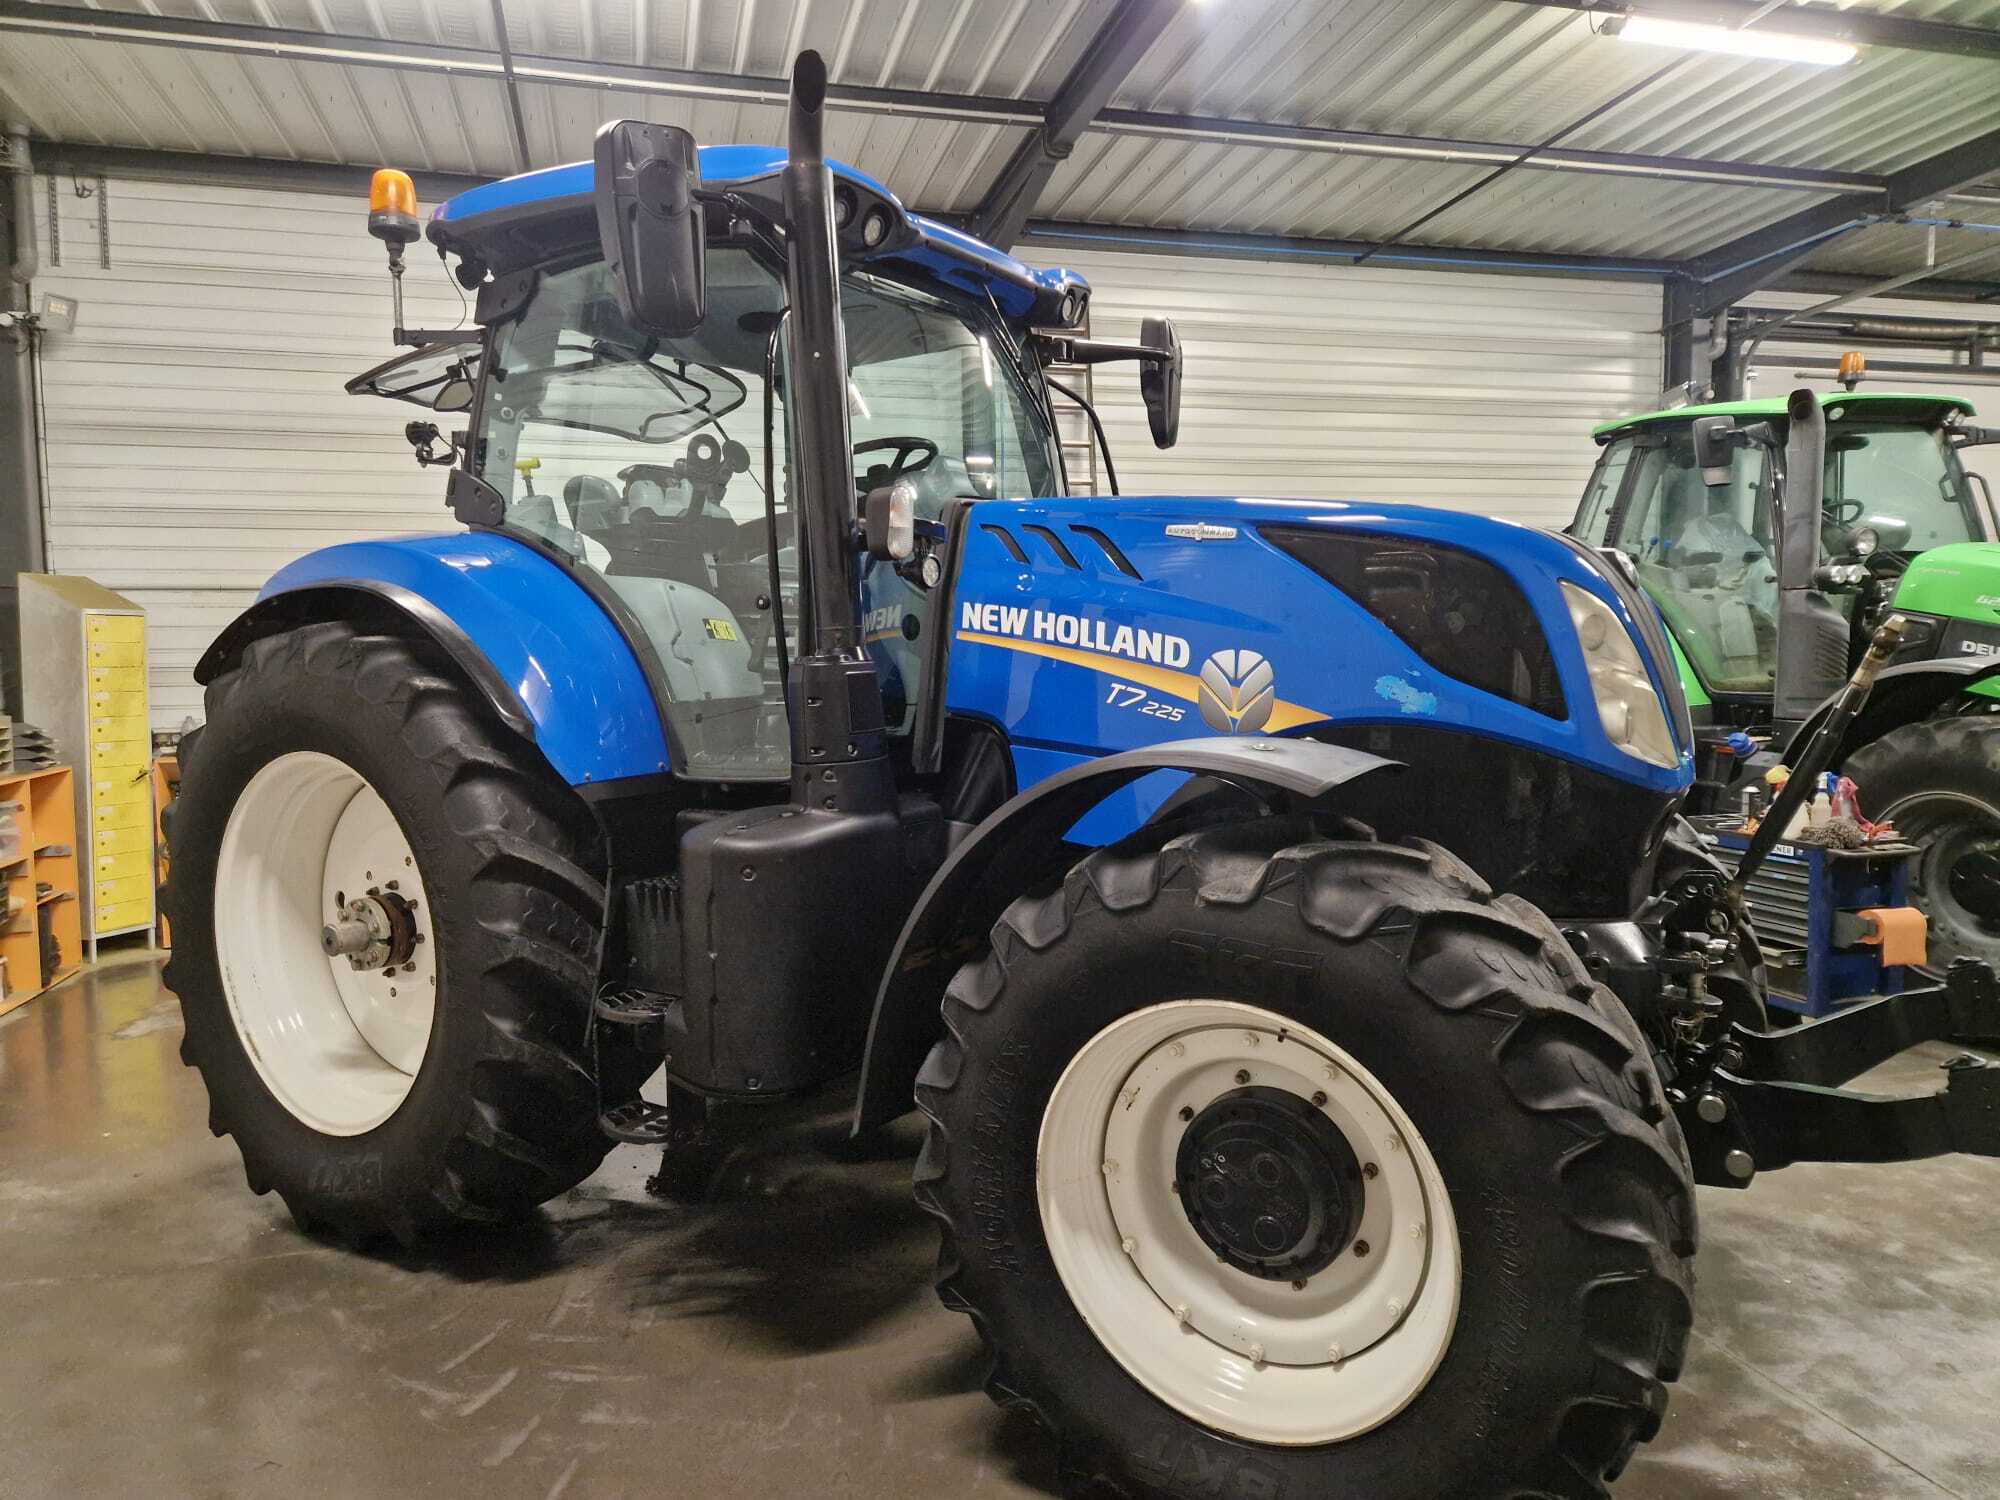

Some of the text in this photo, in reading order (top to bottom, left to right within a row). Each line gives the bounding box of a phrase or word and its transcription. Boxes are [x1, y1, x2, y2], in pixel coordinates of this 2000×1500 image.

[962, 602, 1191, 668] NEW HOLLAND
[1106, 682, 1186, 722] T7.225
